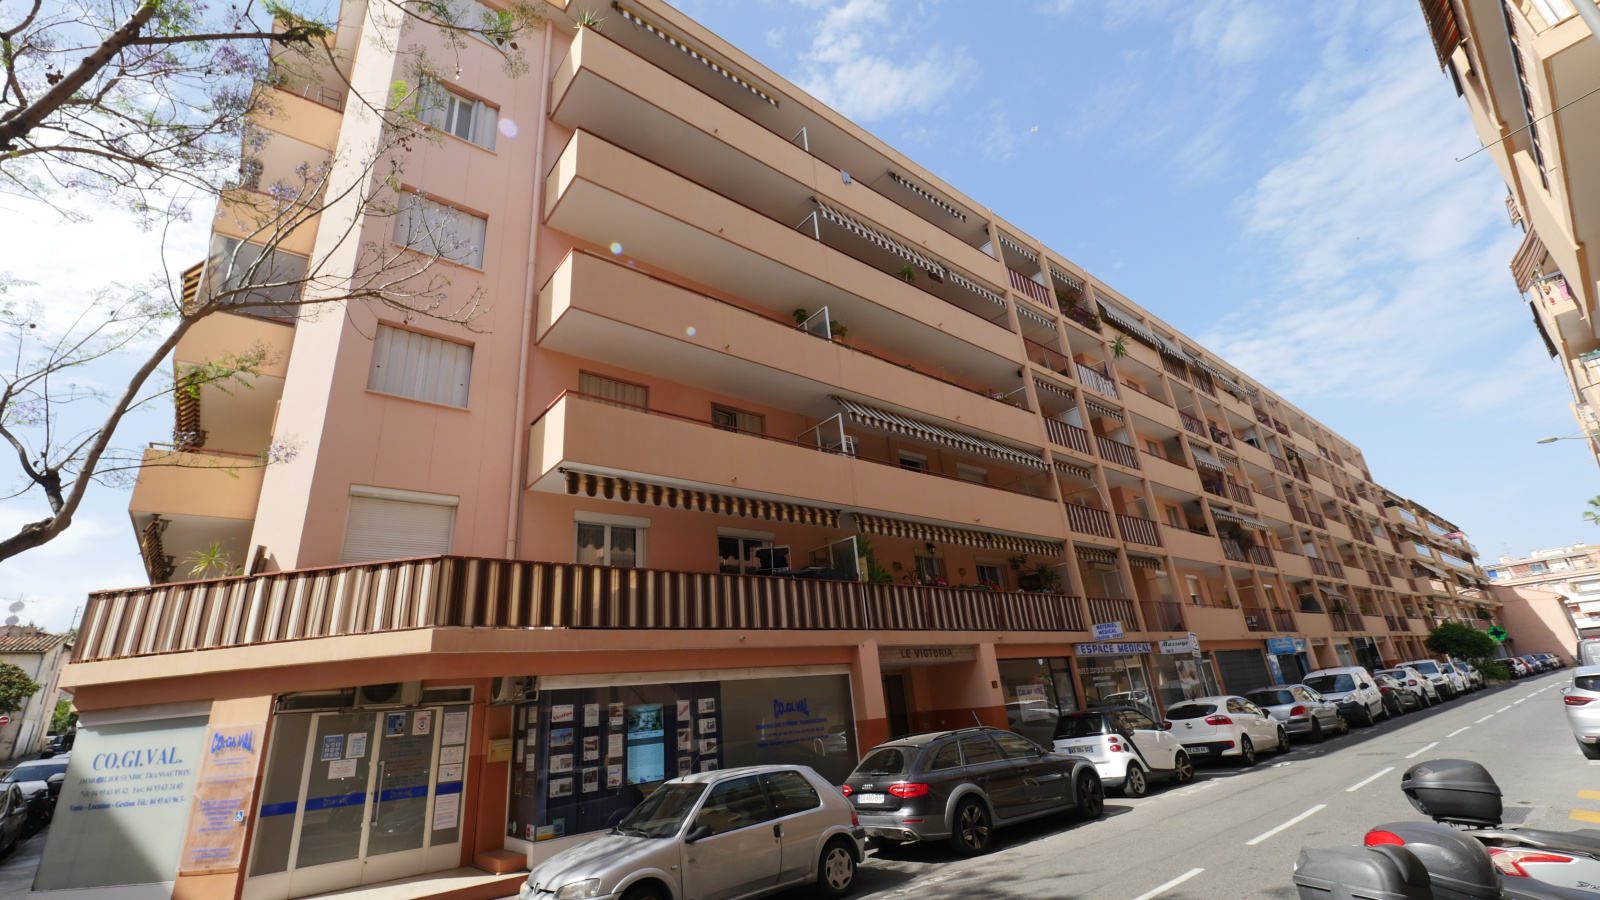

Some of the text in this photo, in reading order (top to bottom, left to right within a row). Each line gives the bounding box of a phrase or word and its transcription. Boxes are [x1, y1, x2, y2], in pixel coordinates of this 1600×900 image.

[900, 648, 953, 658] LE VICTORIA
[1080, 643, 1151, 654] ESPACE MEDICAL
[92, 747, 182, 771] CO.GI.VAL.
[146, 768, 190, 779] TRANSACTION
